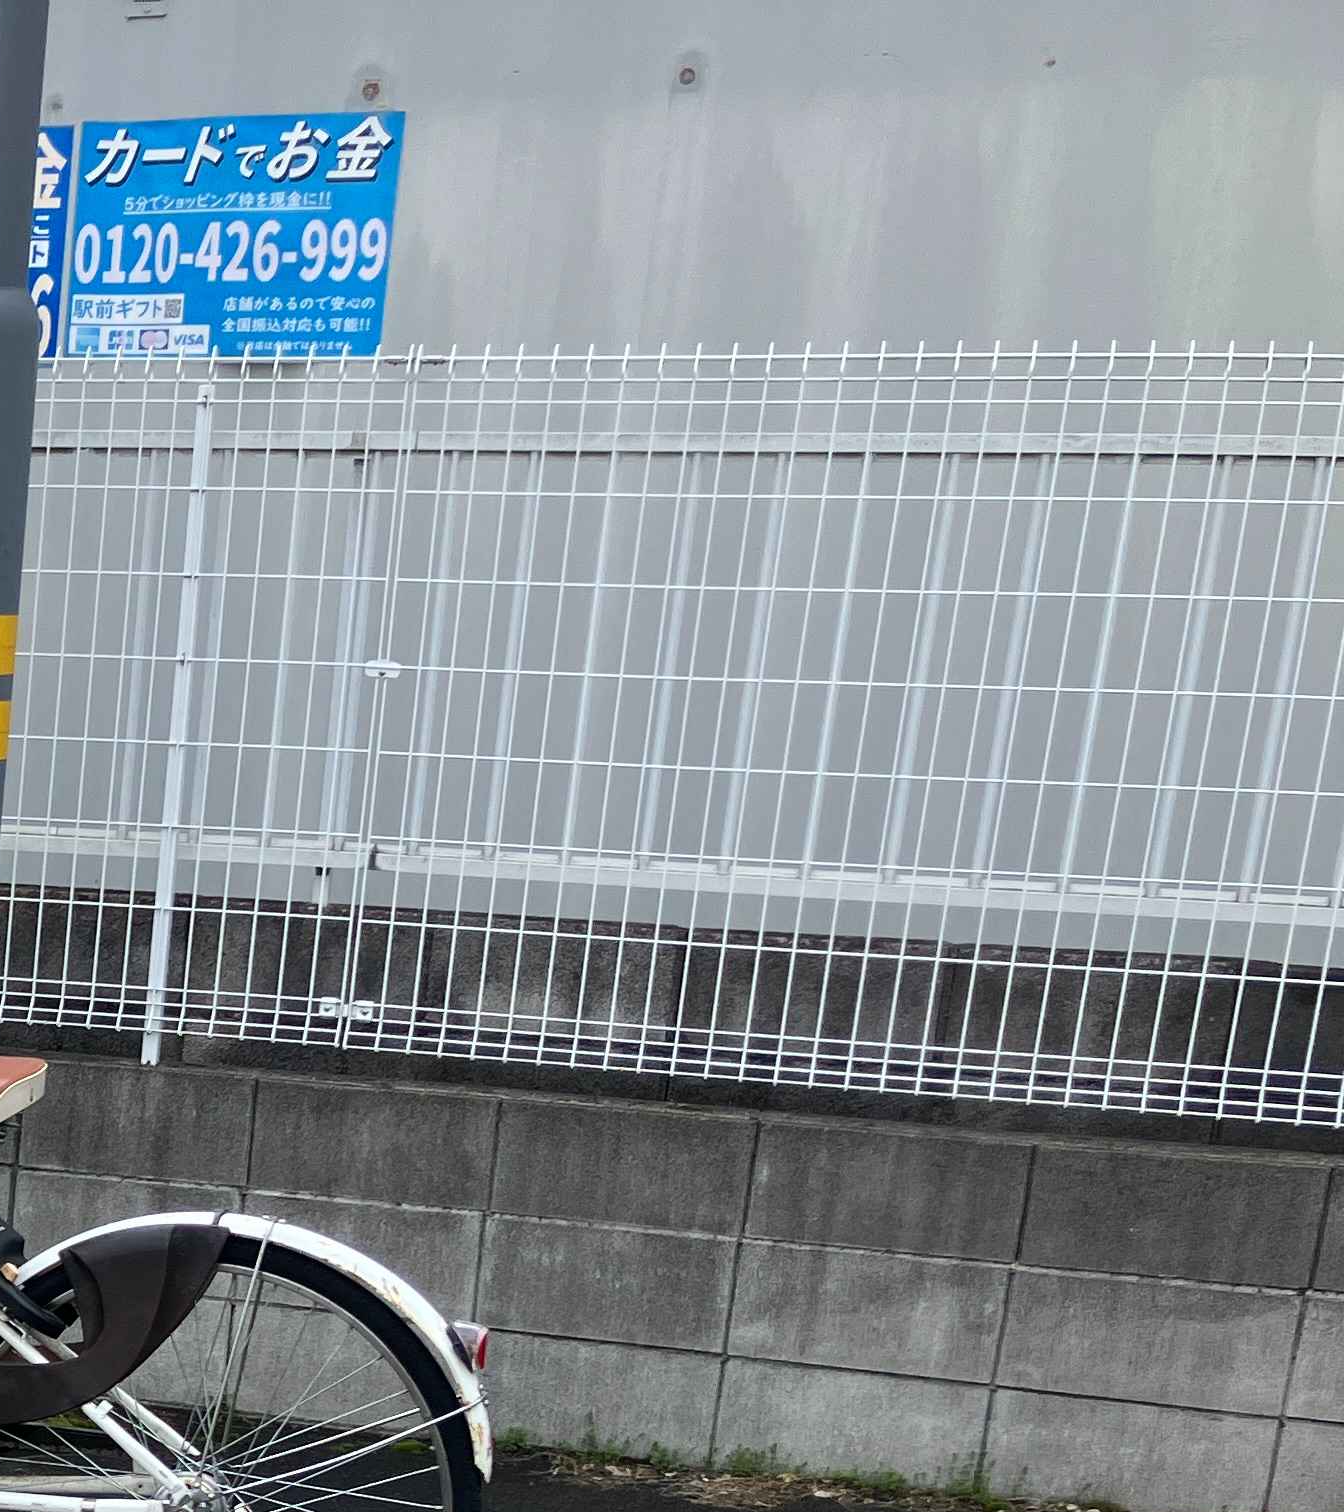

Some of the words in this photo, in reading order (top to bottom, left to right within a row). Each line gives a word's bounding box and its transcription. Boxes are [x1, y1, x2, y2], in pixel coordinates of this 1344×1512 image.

[84, 115, 395, 185] カードでお金
[73, 217, 388, 285] 0120-426-999
[173, 334, 205, 346] VISA
